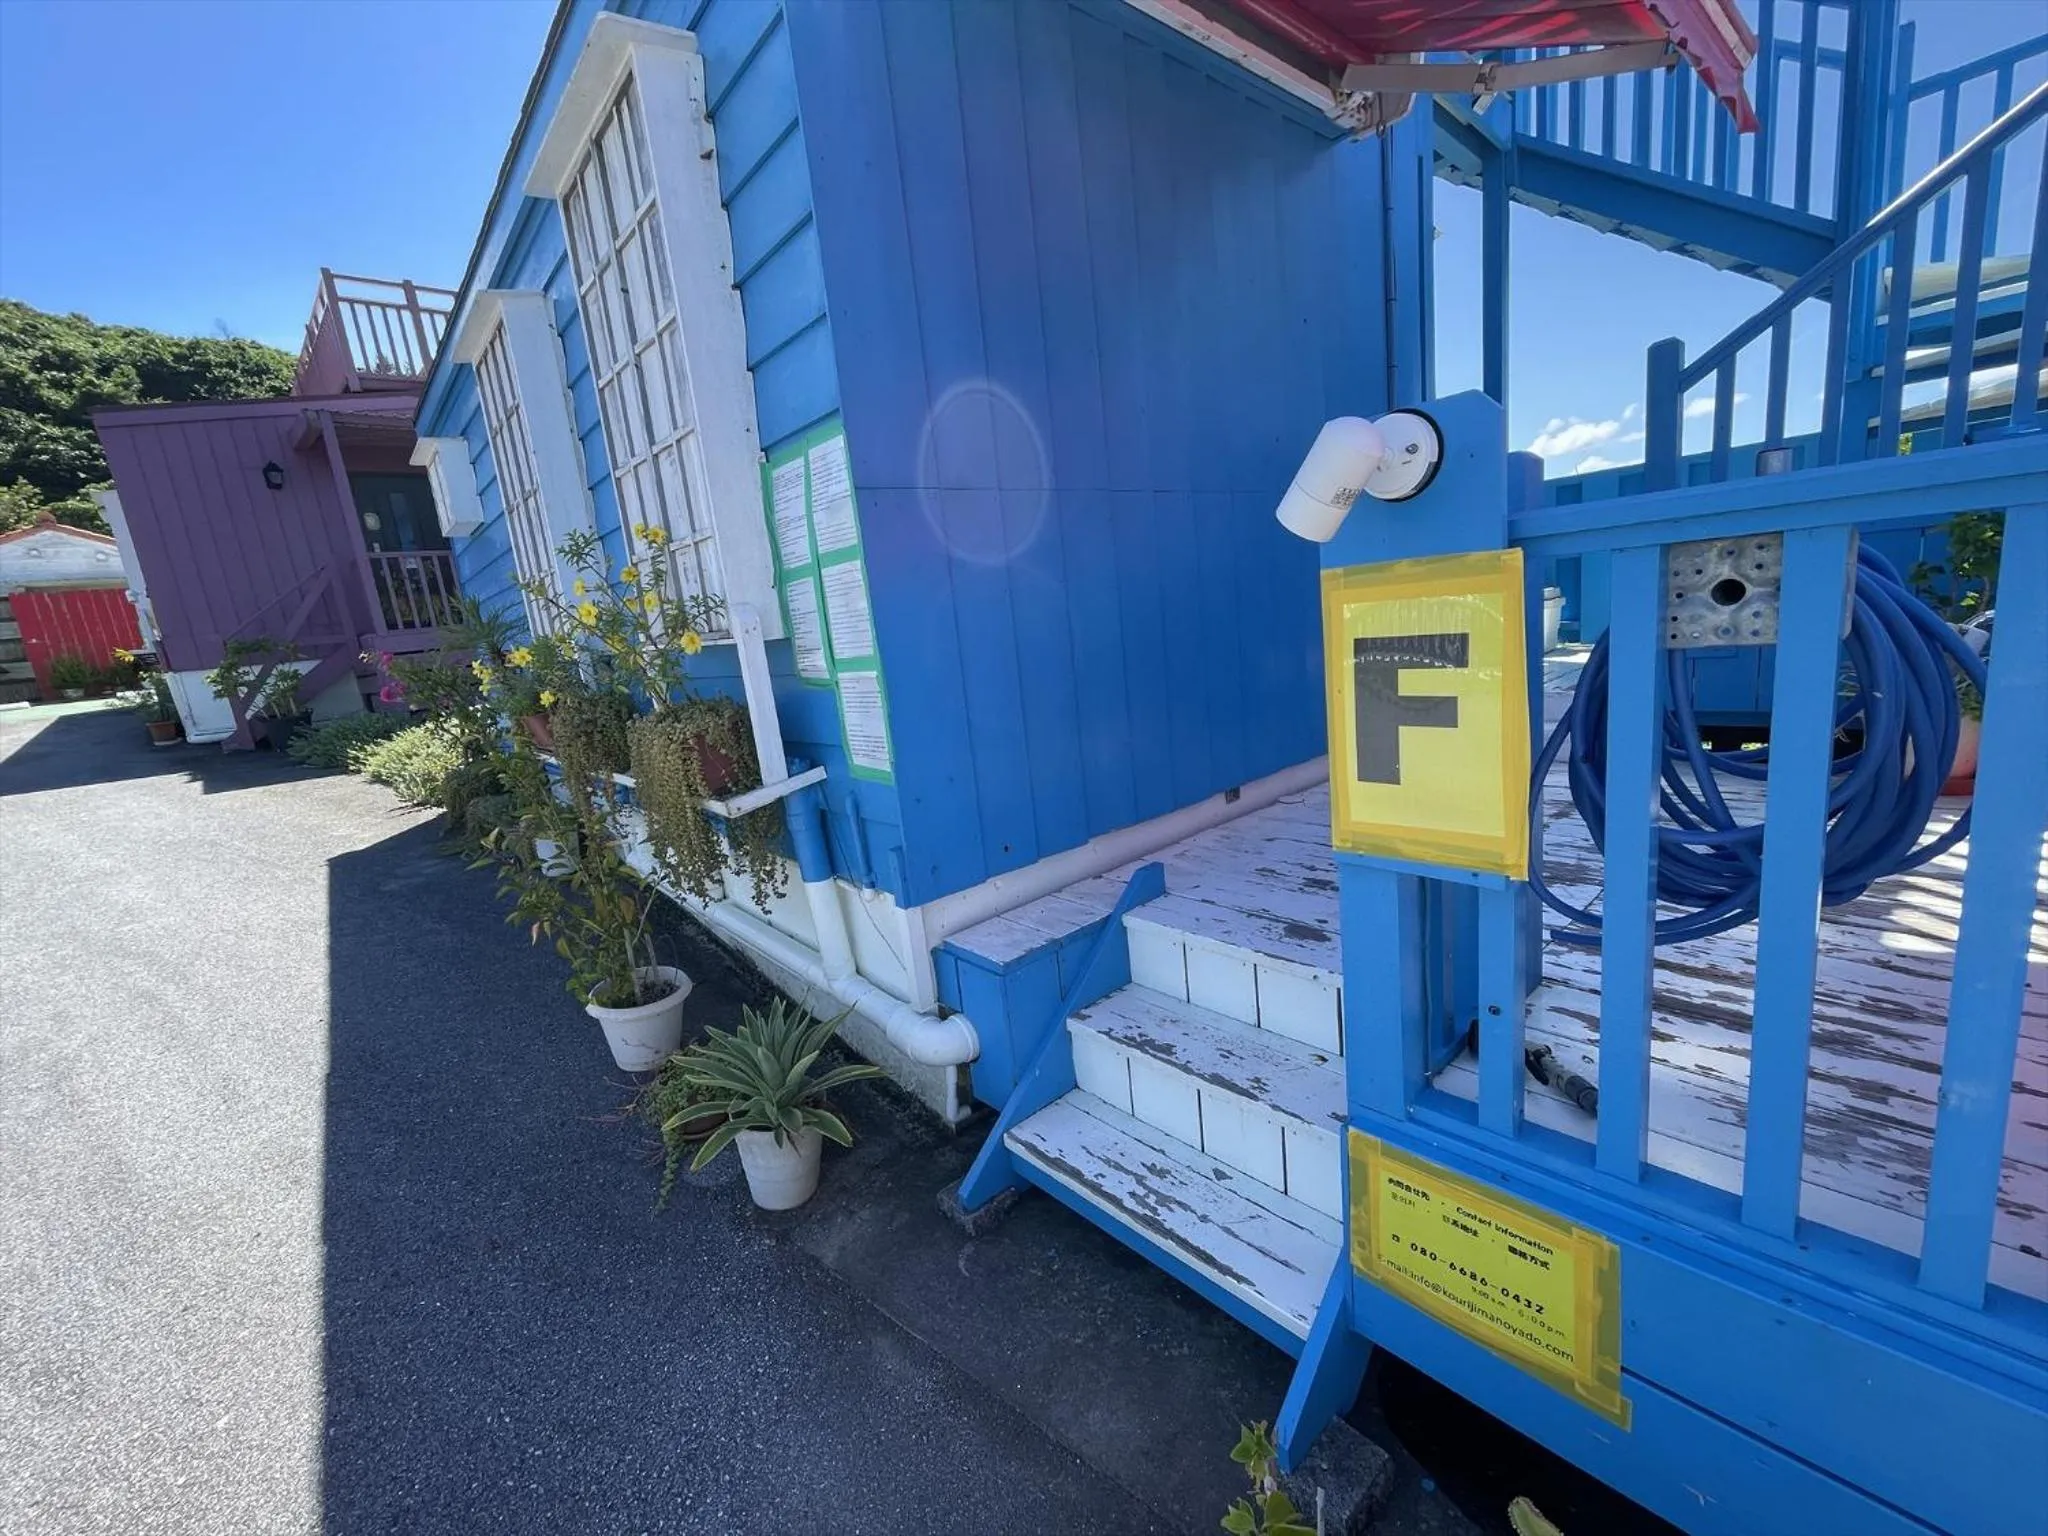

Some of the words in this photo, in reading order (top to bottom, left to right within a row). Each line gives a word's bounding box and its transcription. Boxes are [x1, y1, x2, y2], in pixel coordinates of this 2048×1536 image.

[1353, 632, 1470, 786] F
[1456, 1206, 1492, 1228] Contact
[1410, 1243, 1545, 1315] 080-6686-0432
